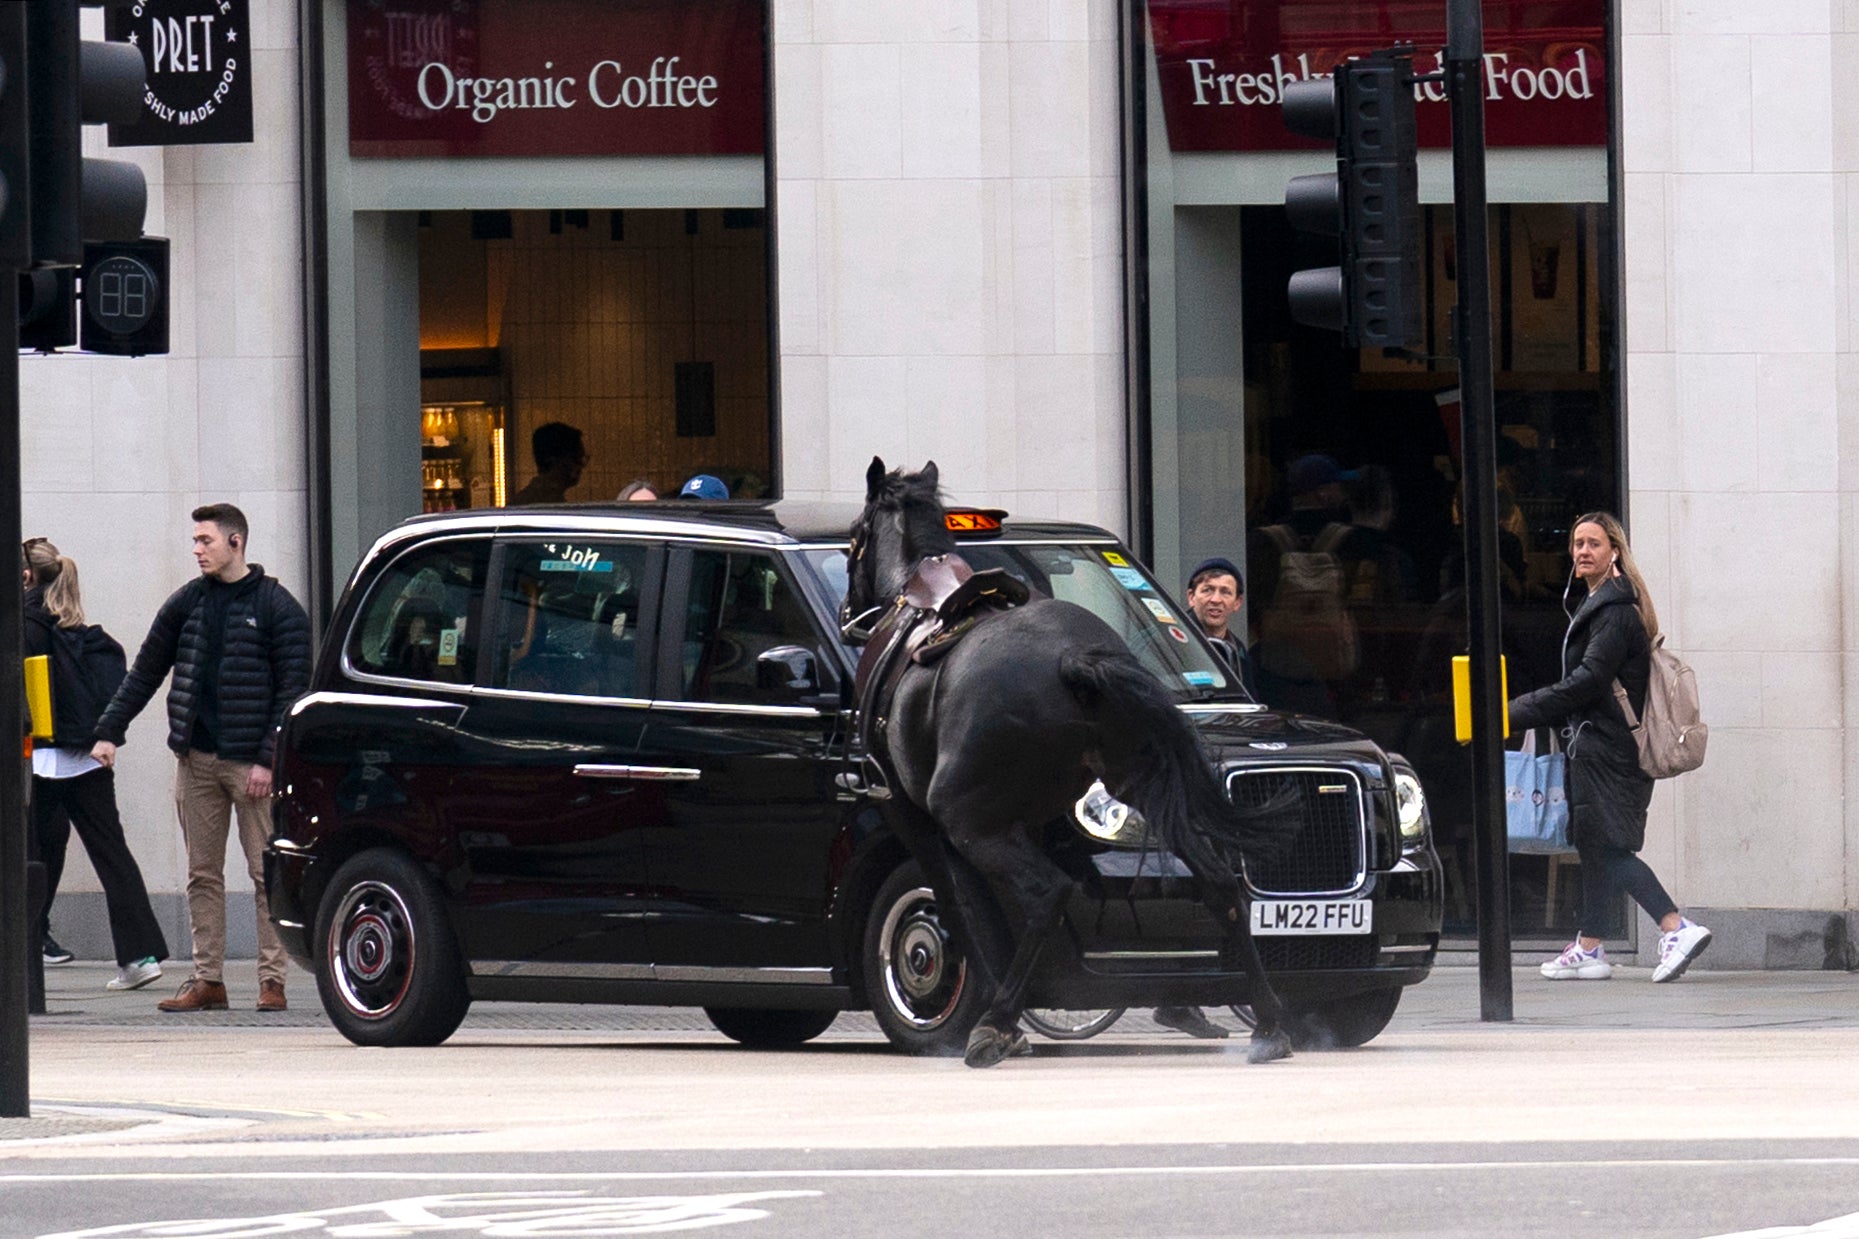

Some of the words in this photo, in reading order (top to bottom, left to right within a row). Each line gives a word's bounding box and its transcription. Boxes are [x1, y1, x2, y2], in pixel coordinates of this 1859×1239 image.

[152, 15, 215, 73] PRET
[143, 82, 176, 122] SHLY
[179, 100, 215, 125] MADE
[213, 58, 237, 104] FOOD
[417, 61, 577, 123] Organic
[588, 56, 718, 108] Coffee
[1186, 53, 1335, 105] Freshl
[1482, 48, 1594, 100] Food
[946, 515, 996, 529] AXI
[1260, 904, 1318, 929] LM22
[1324, 903, 1364, 929] FFU
